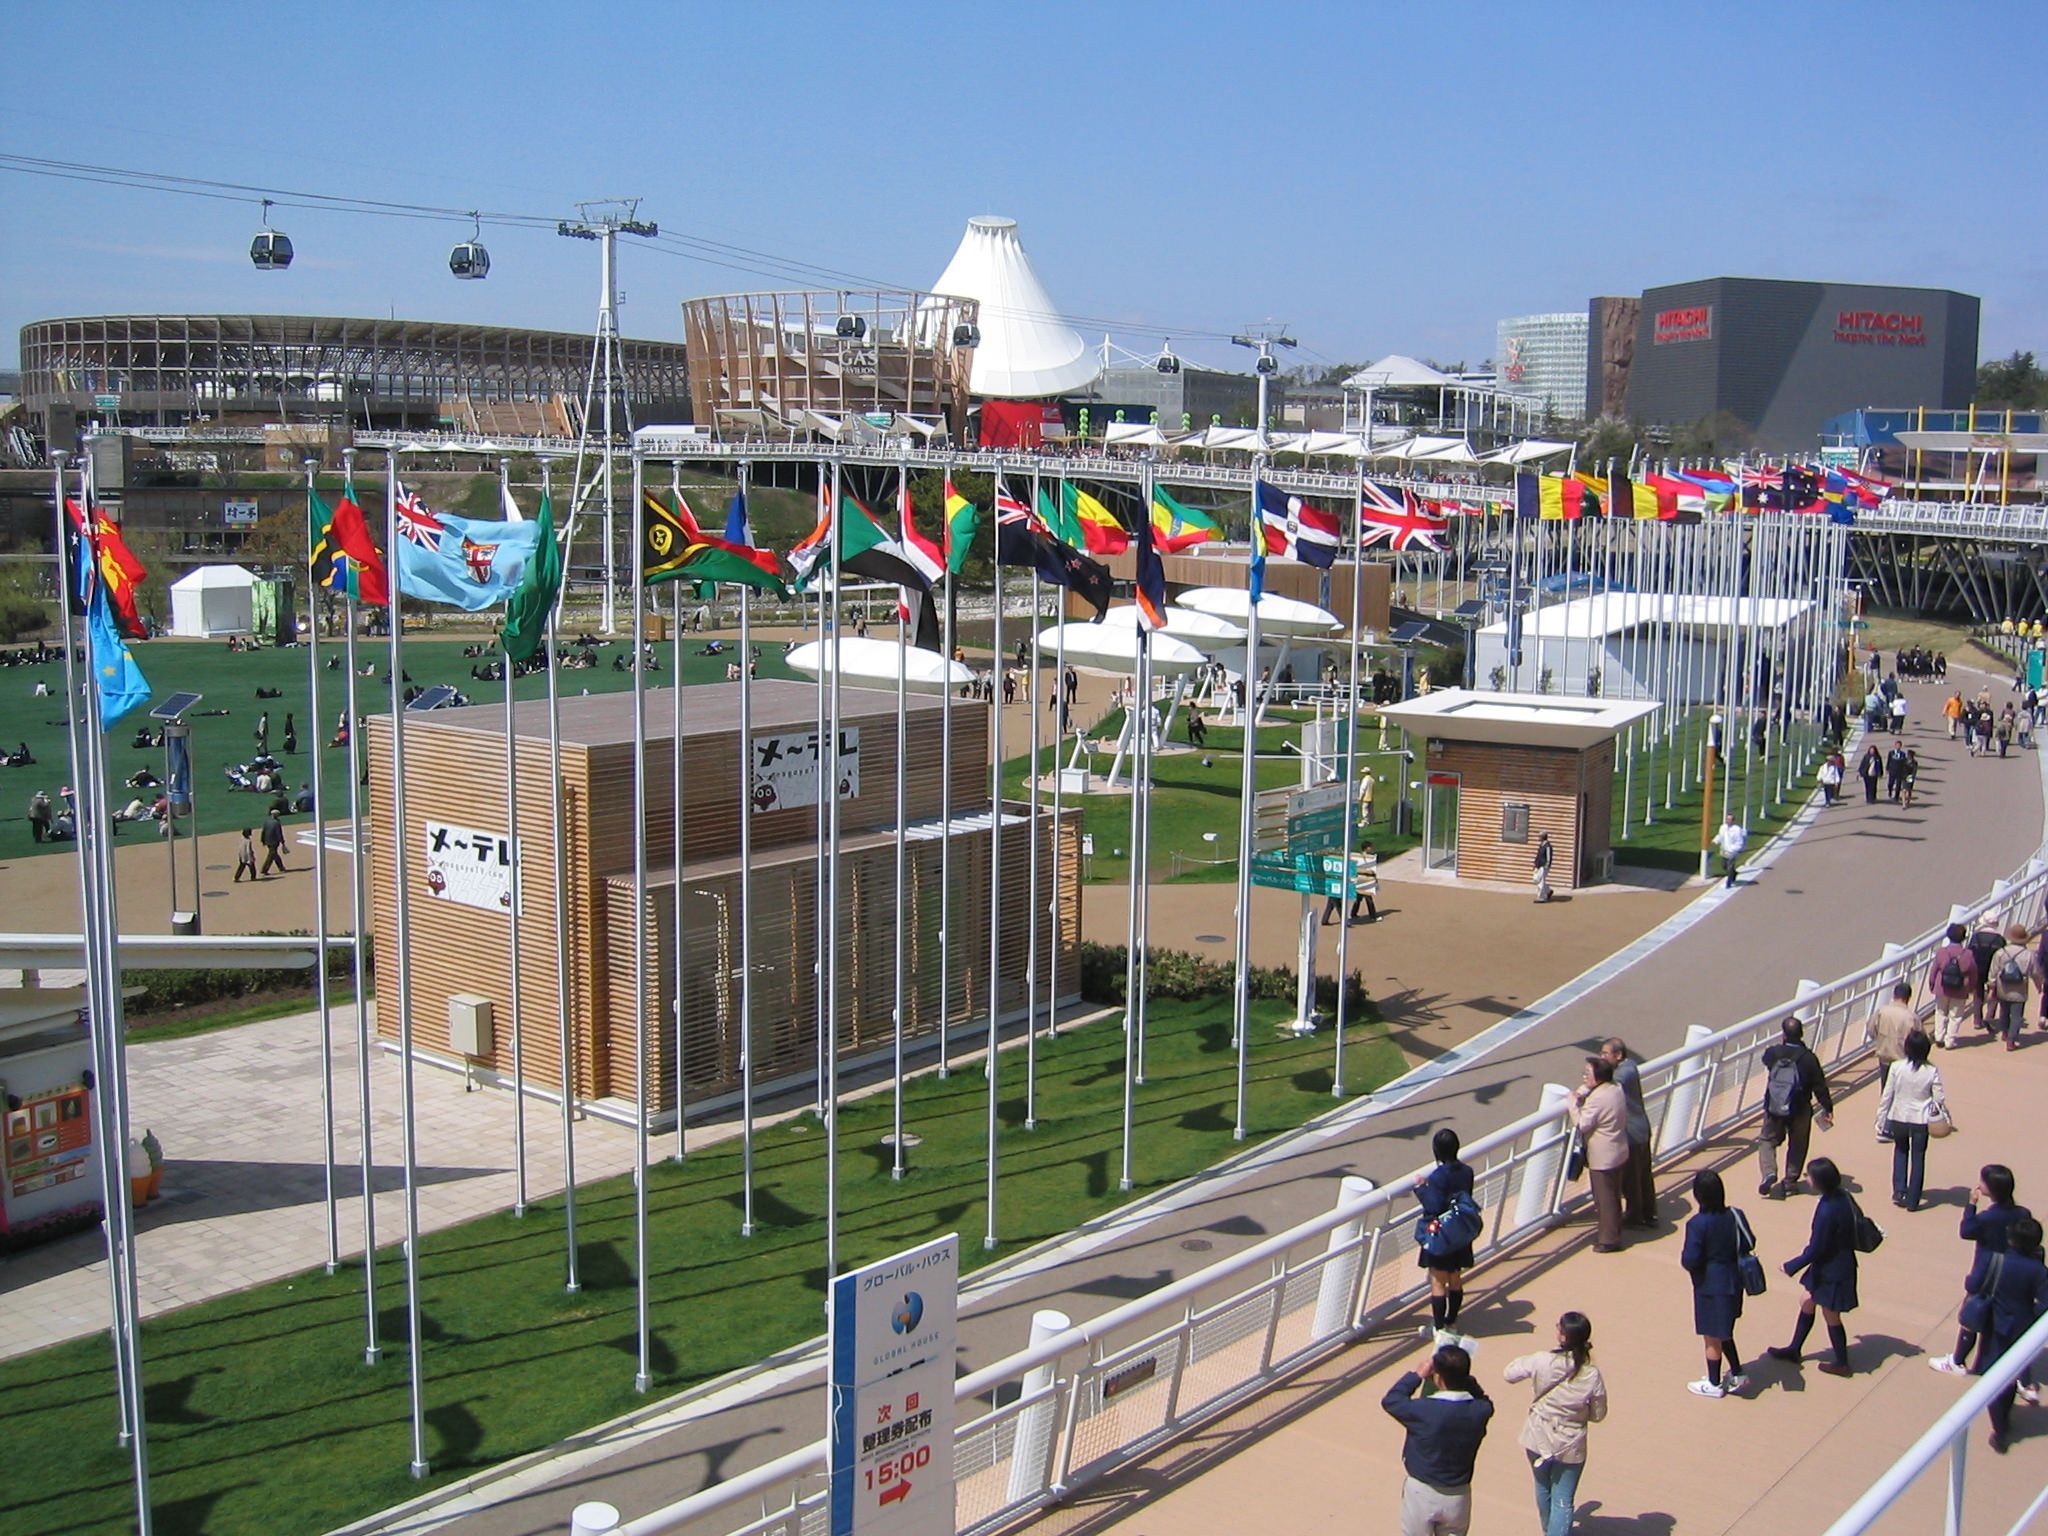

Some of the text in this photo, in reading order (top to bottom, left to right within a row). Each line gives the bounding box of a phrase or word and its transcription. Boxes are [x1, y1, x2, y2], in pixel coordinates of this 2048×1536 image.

[1658, 307, 1708, 327] HITACHI
[1838, 311, 1923, 331] HITACHI
[841, 350, 878, 366] GAS
[863, 1248, 951, 1292] グローバル・ハウス
[873, 1331, 940, 1366] GLOBAL HOUSE
[862, 1408, 933, 1454] 整理券配布
[865, 1444, 930, 1490] 15:00
